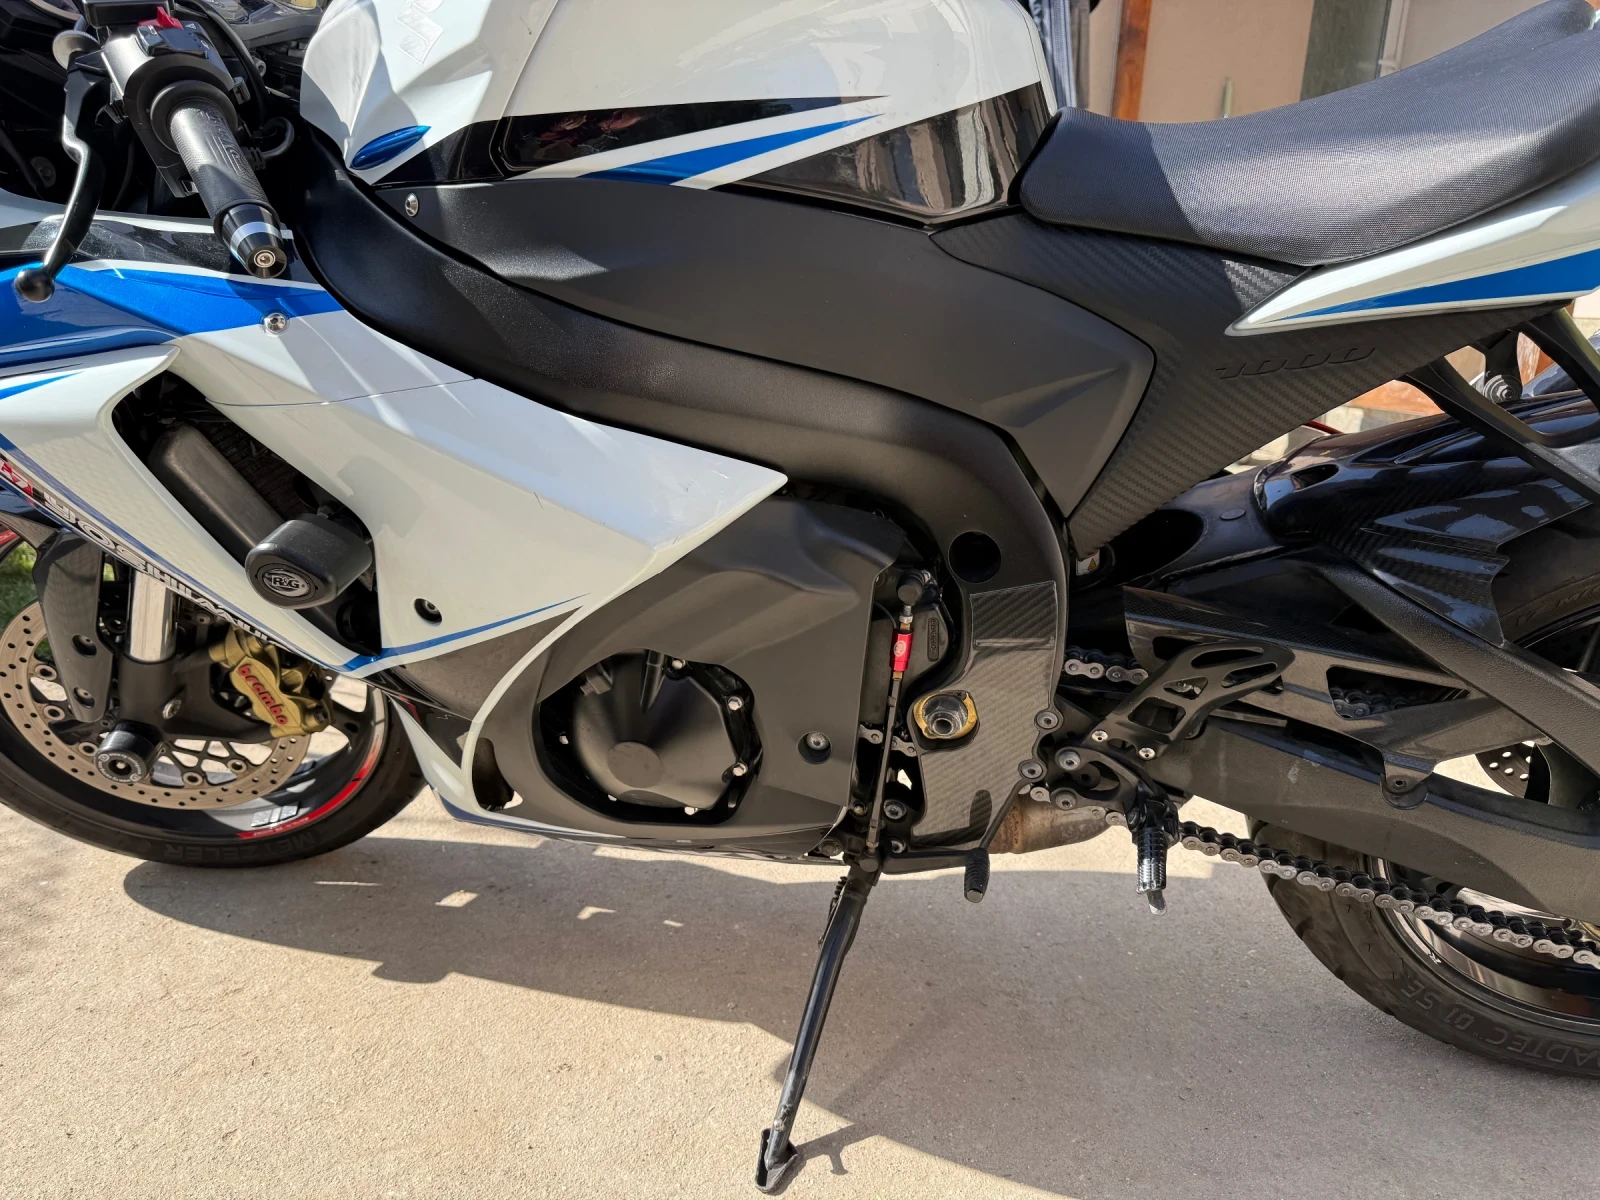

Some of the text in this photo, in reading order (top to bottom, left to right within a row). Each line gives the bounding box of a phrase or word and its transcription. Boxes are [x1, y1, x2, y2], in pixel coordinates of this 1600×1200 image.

[1215, 347, 1376, 380] 1000
[273, 576, 300, 589] R&G
[238, 663, 288, 725] brembo
[163, 831, 316, 861] METZELER
[1401, 978, 1600, 1067] ADTEC 01 SE
